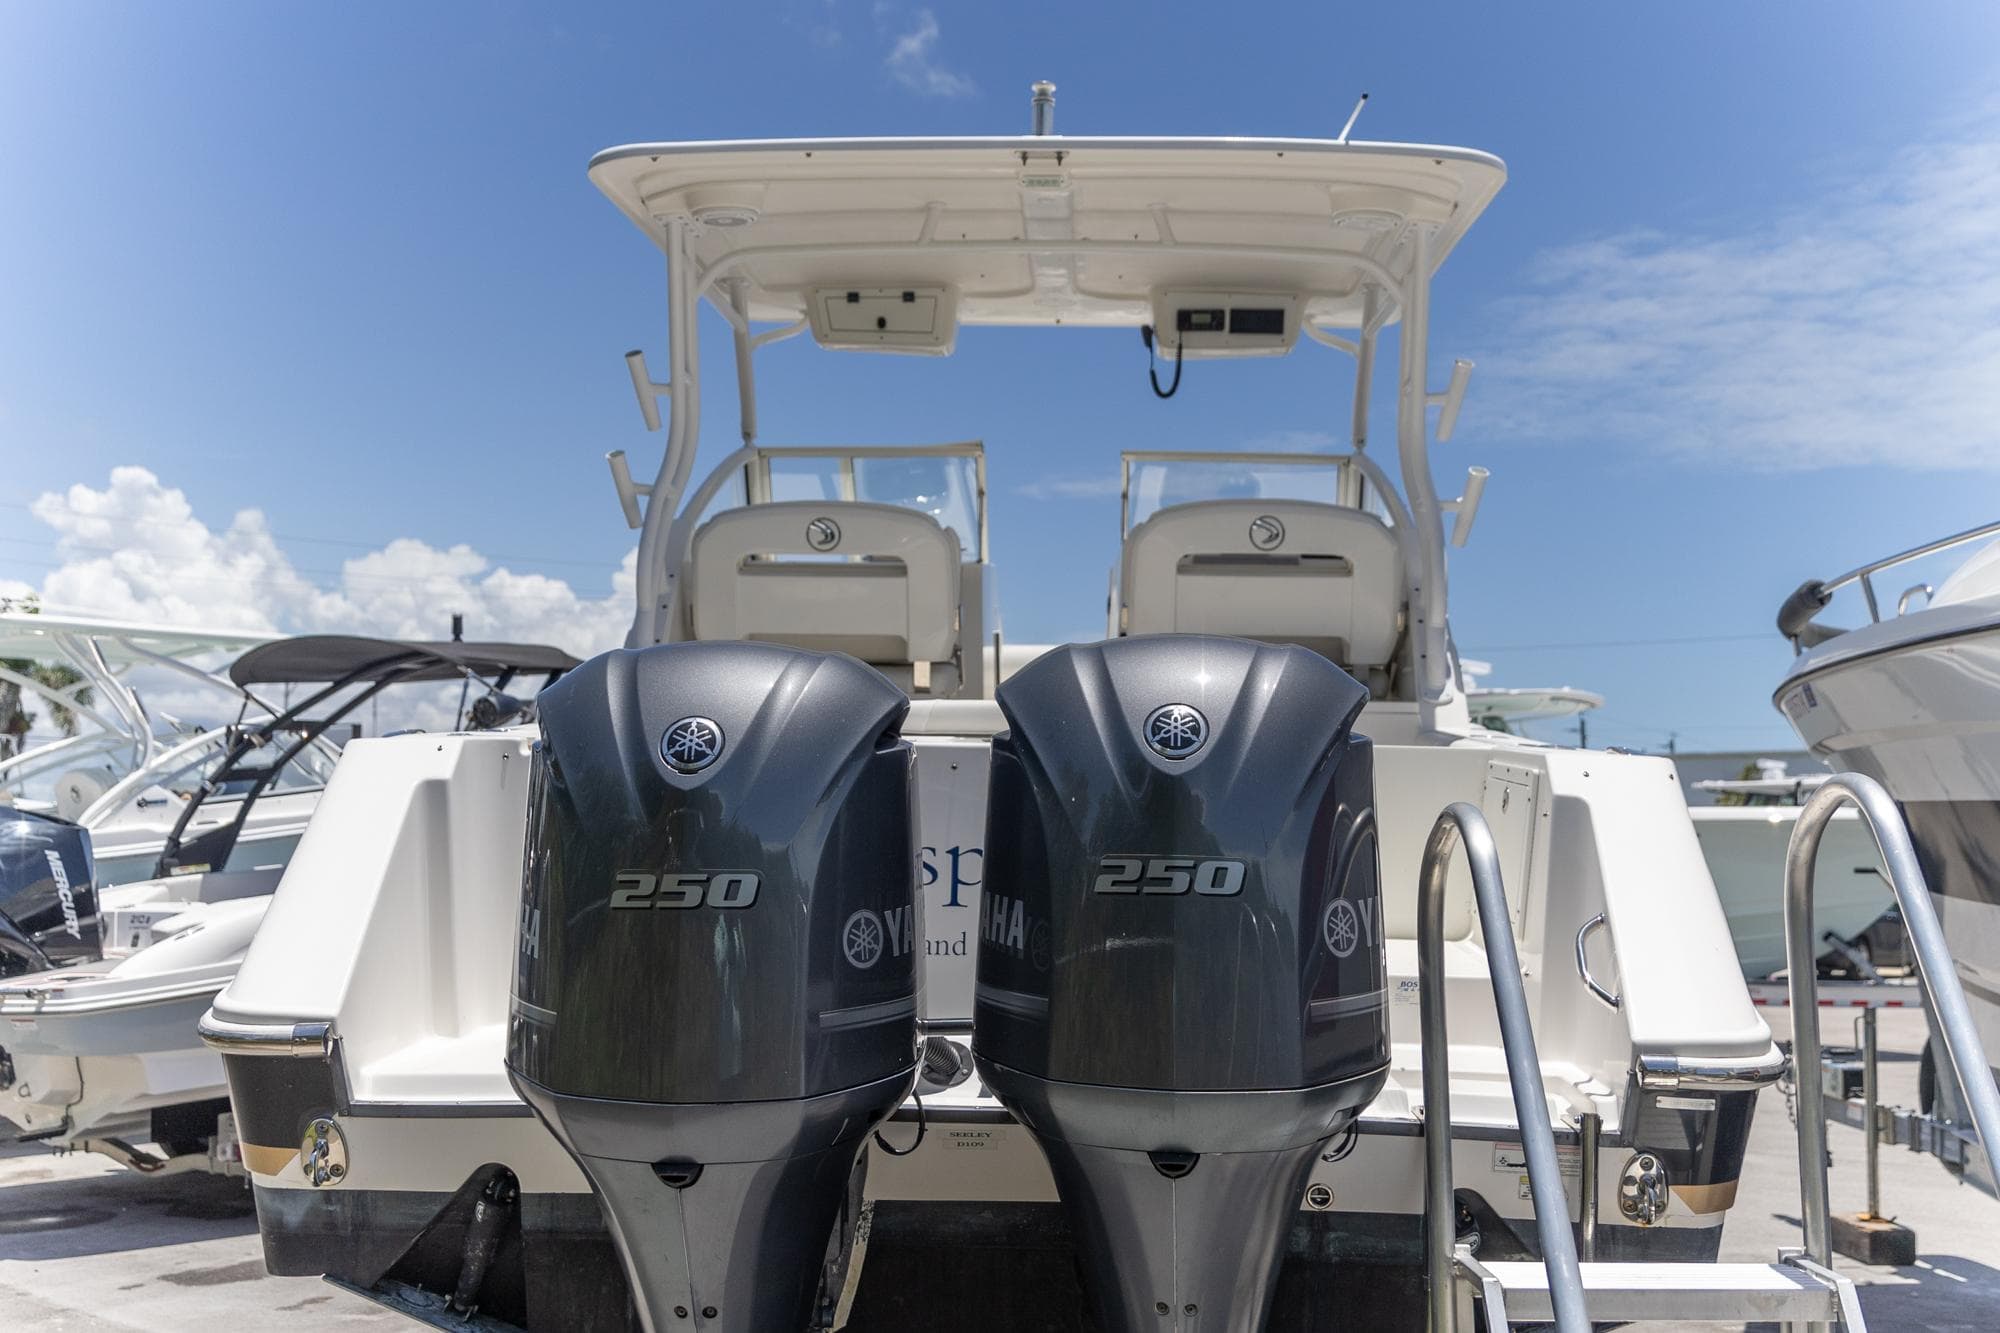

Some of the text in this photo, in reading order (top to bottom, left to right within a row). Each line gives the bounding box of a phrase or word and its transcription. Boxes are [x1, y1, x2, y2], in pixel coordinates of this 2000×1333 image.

[44, 849, 81, 940] MERCURY
[610, 873, 761, 909] 250
[1094, 858, 1246, 896] 250
